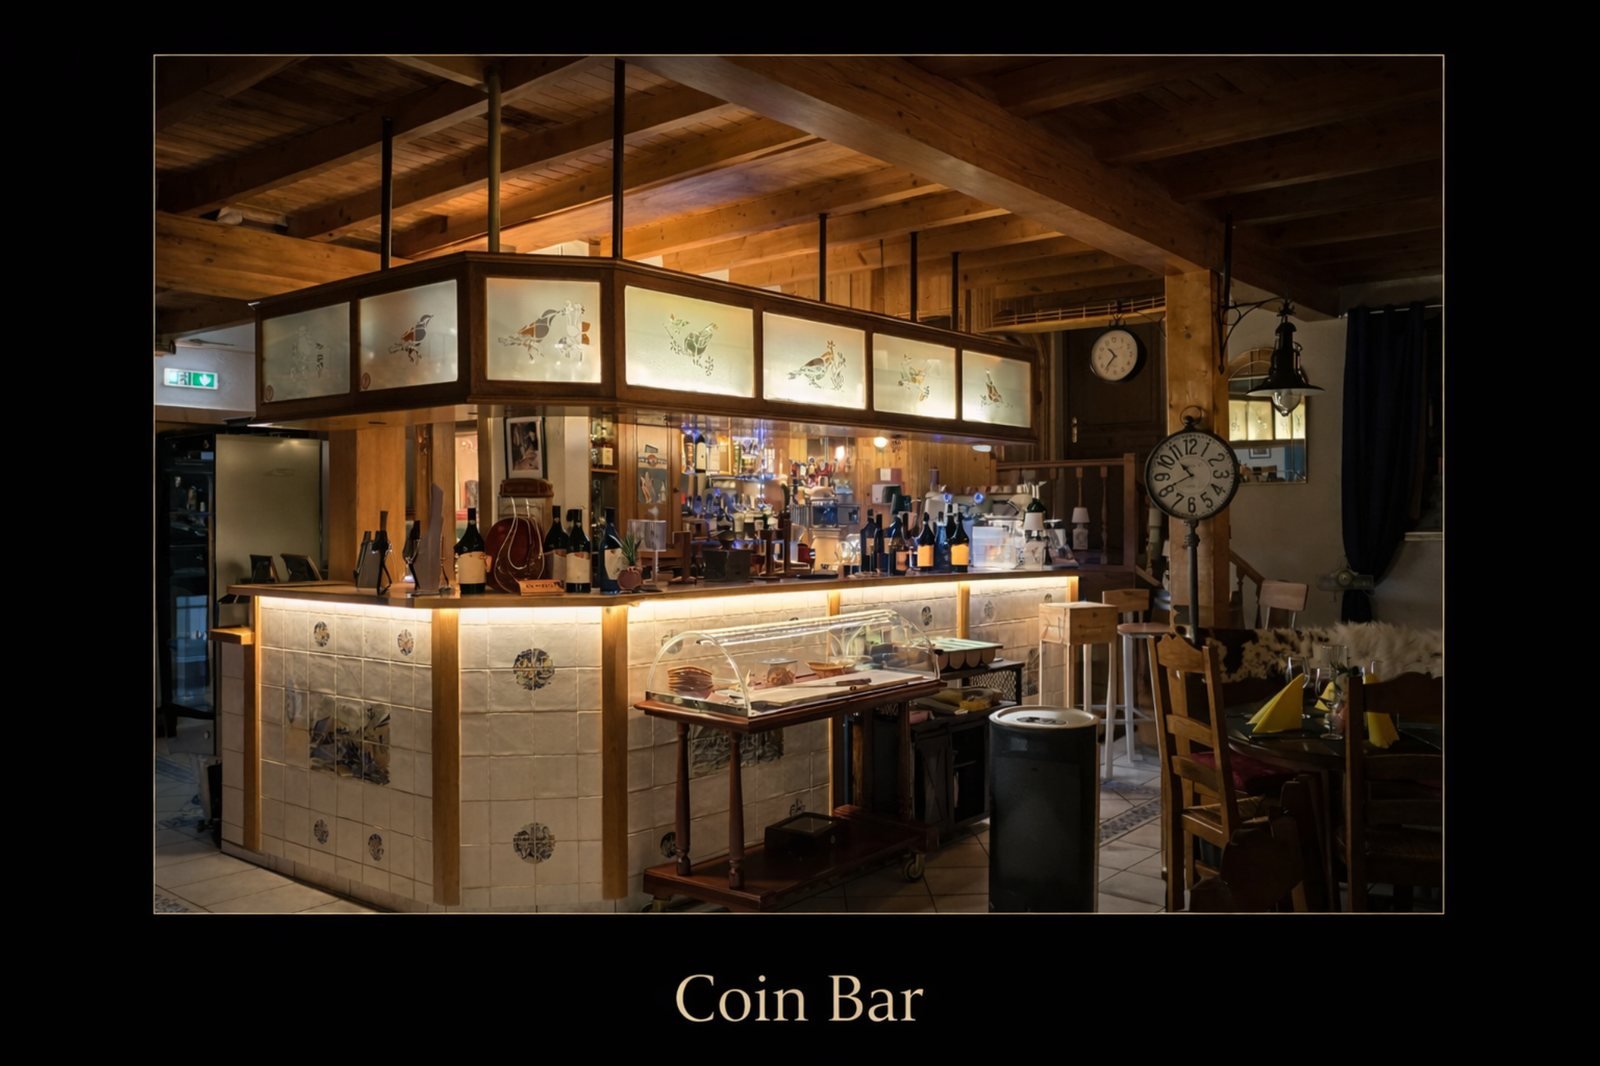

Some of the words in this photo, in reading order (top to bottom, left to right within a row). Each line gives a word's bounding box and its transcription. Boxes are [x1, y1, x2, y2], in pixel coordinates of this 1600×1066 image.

[1169, 444, 1183, 460] 11
[1183, 438, 1197, 455] 12
[1201, 442, 1210, 457] 1
[1157, 454, 1175, 470] 10
[1208, 453, 1225, 467] 2
[1154, 472, 1170, 481] 9
[1213, 470, 1229, 479] 3
[1158, 484, 1174, 498] 8
[1211, 483, 1226, 496] 4
[1171, 493, 1184, 509] 7
[1187, 496, 1196, 513] 6
[1200, 492, 1213, 508] 5
